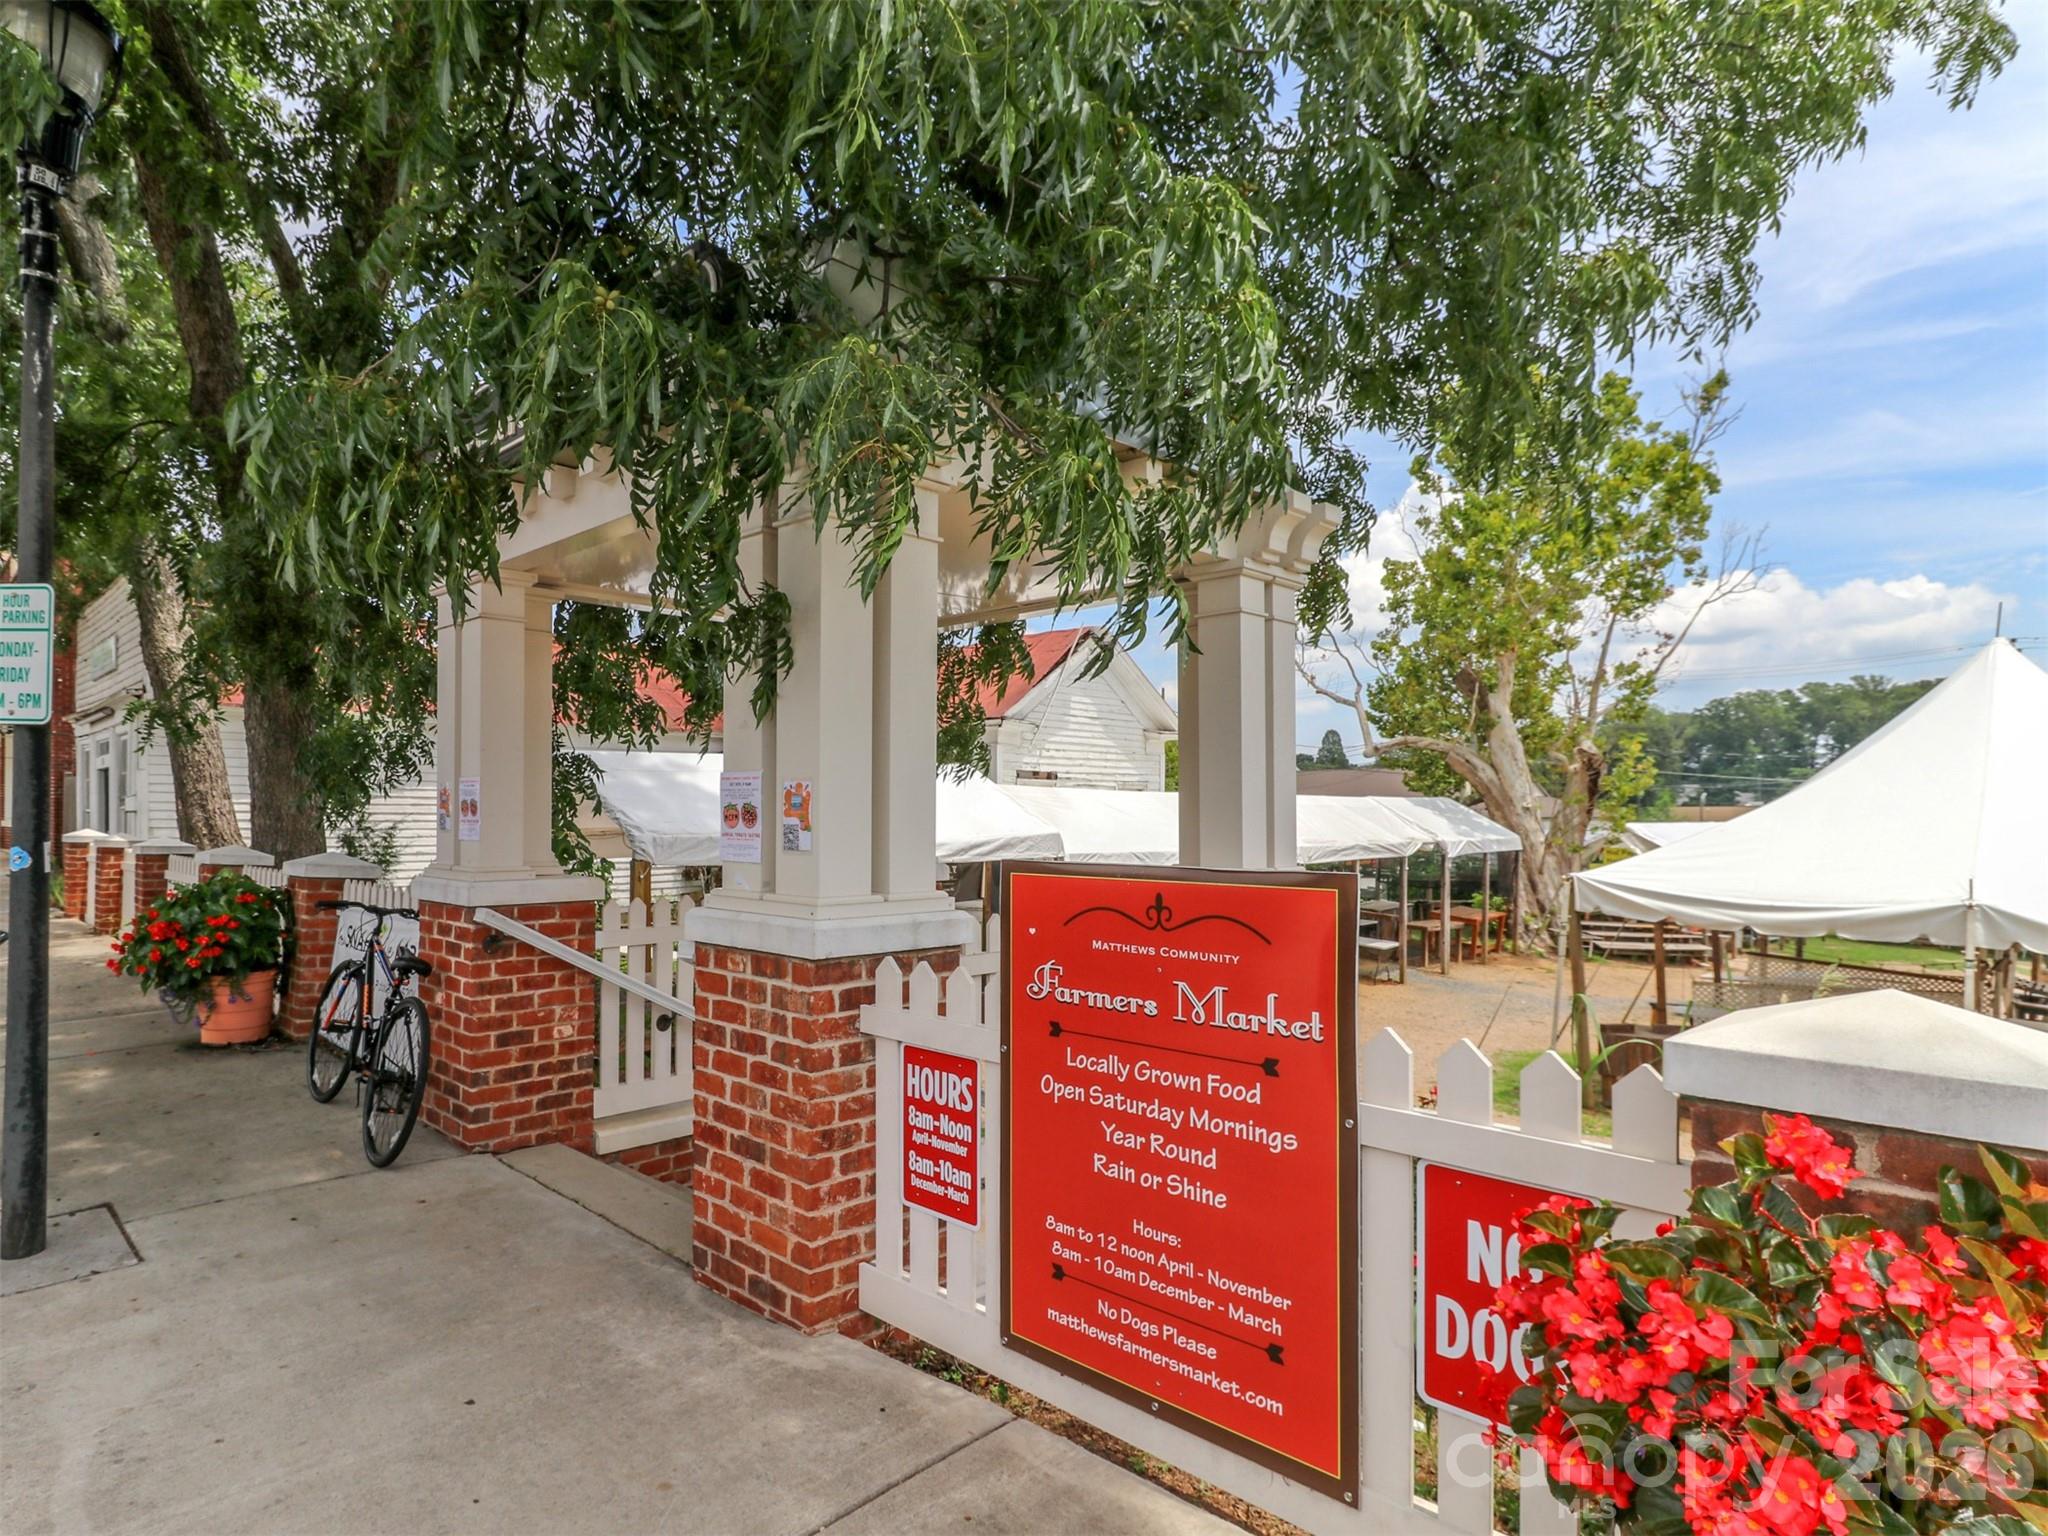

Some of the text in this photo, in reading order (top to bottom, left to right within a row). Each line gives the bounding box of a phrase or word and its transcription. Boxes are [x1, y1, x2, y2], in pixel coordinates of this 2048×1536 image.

[2, 594, 30, 608] HOUR
[2, 610, 46, 624] PARKING
[0, 642, 38, 657] ONDAY-
[0, 667, 30, 682] RIDAY
[18, 693, 42, 708] 6PM
[1026, 960, 1325, 1042] Farmers Market
[907, 1063, 973, 1113] HOURS
[1066, 1047, 1261, 1105] Locally Grown Food
[908, 1105, 972, 1143] 8am-Noon
[1040, 1074, 1298, 1153] Open Saturday Mornings
[912, 1129, 968, 1158] April-November
[1100, 1120, 1217, 1170] Year Round
[908, 1149, 972, 1190] 8am-10am
[911, 1173, 968, 1205] December-March
[1093, 1153, 1227, 1209] Rain or Shine
[1133, 1219, 1182, 1248] Hours:
[1045, 1215, 1075, 1238] 8am
[1077, 1227, 1093, 1243] to
[1097, 1233, 1117, 1252] 12
[1121, 1244, 1154, 1265] noon
[1157, 1253, 1194, 1278] April
[1207, 1270, 1292, 1311] November
[1052, 1240, 1081, 1263] 8am
[1094, 1255, 1136, 1283] 10am
[1138, 1271, 1215, 1311] December
[1228, 1303, 1282, 1336] March
[1097, 1299, 1217, 1360] No Dogs Please
[1436, 1294, 1571, 1392] DOG
[1047, 1306, 1283, 1416] matthewsfarmersmarket.com
